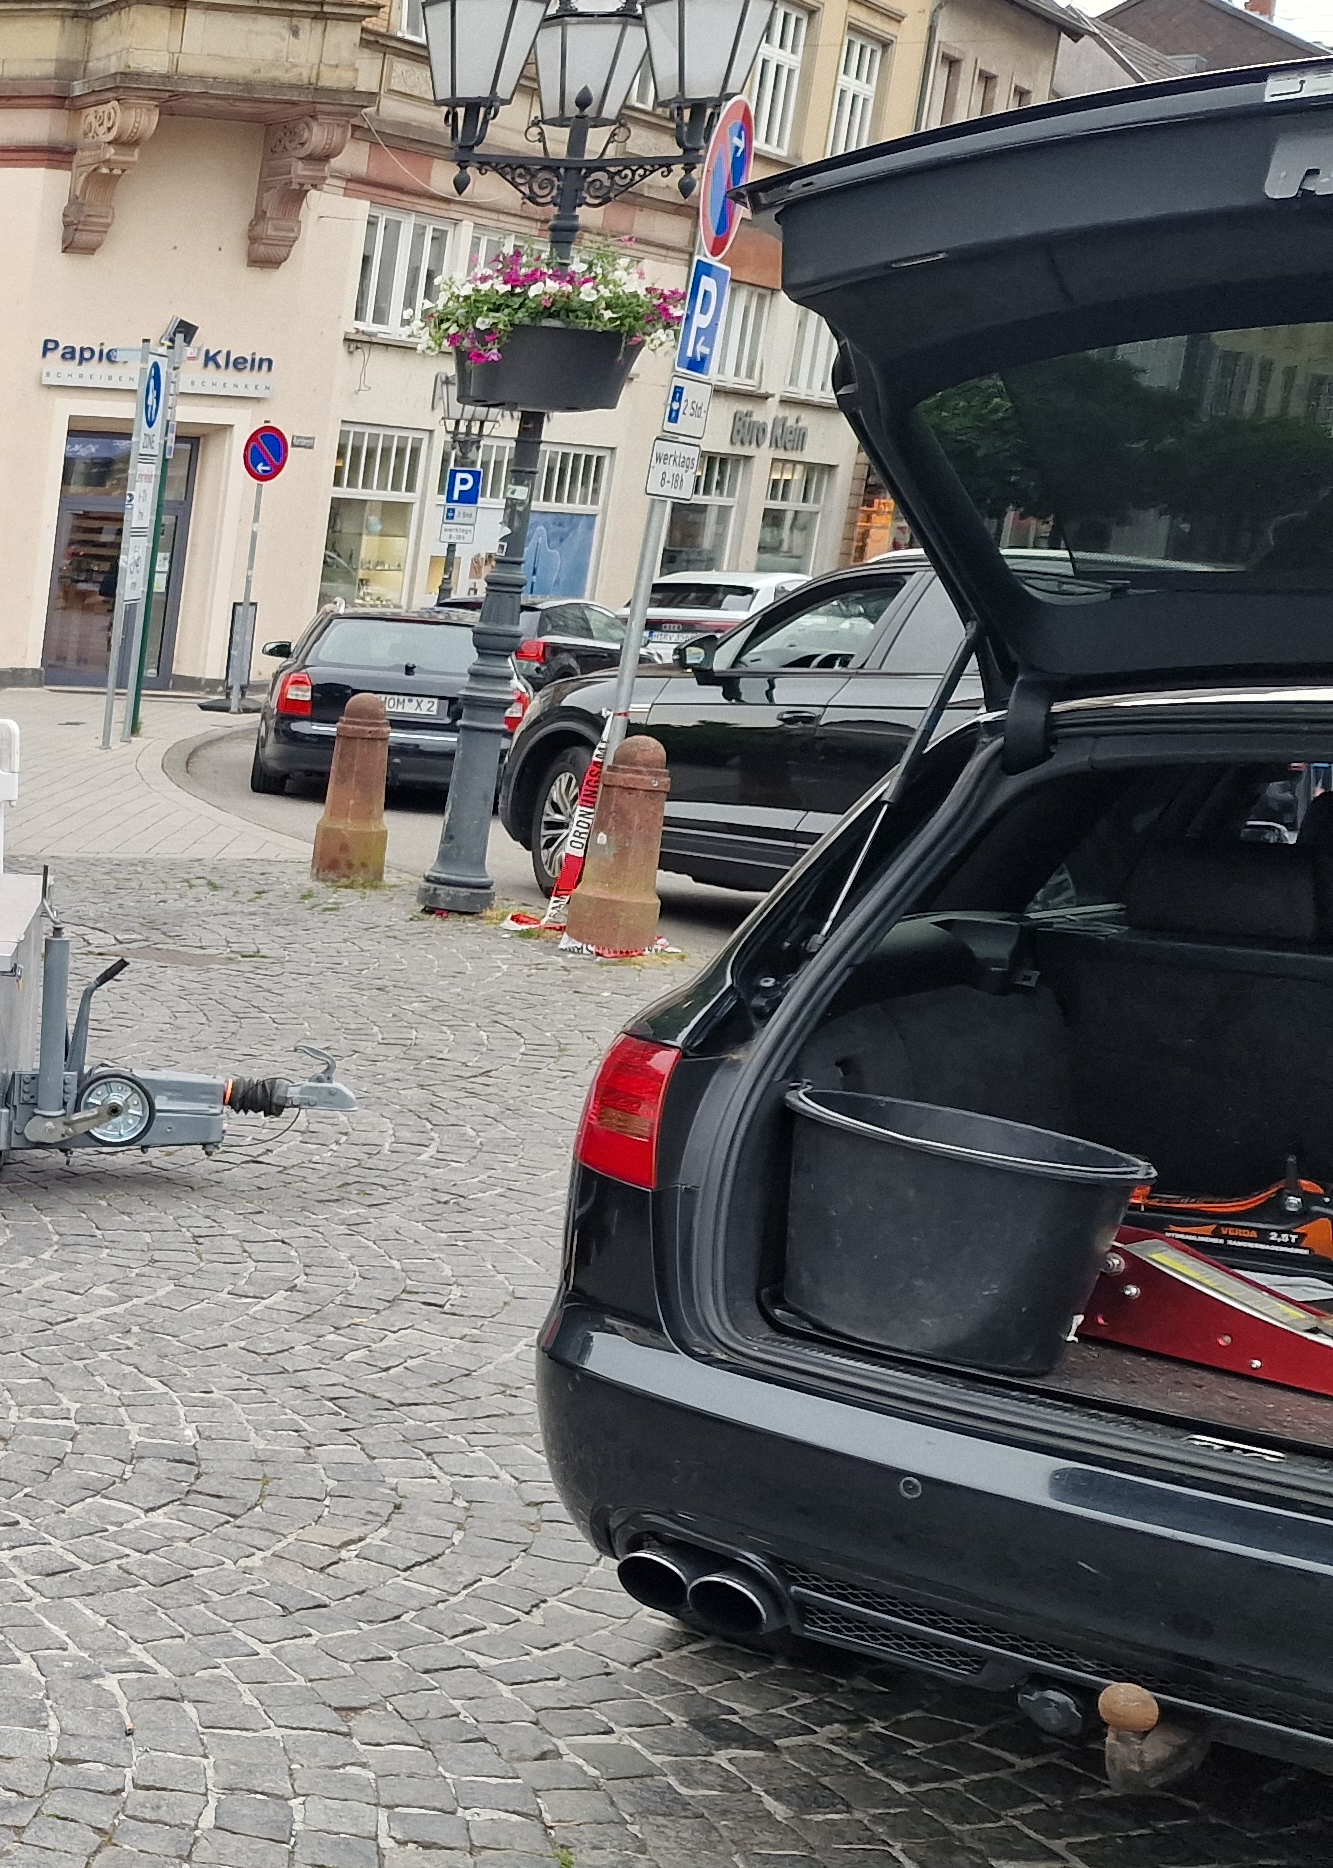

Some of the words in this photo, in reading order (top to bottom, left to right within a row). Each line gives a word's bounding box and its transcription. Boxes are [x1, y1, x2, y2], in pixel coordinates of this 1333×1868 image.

[686, 274, 717, 358] P
[41, 338, 129, 366] Papie
[203, 348, 274, 373] Klein
[45, 371, 135, 382] SCHREIBEN
[190, 380, 271, 391] SCHENKEN
[682, 399, 689, 415] 2
[730, 410, 768, 448] Büro
[769, 415, 808, 452] Klein
[655, 450, 696, 473] werktags
[453, 472, 473, 501] P
